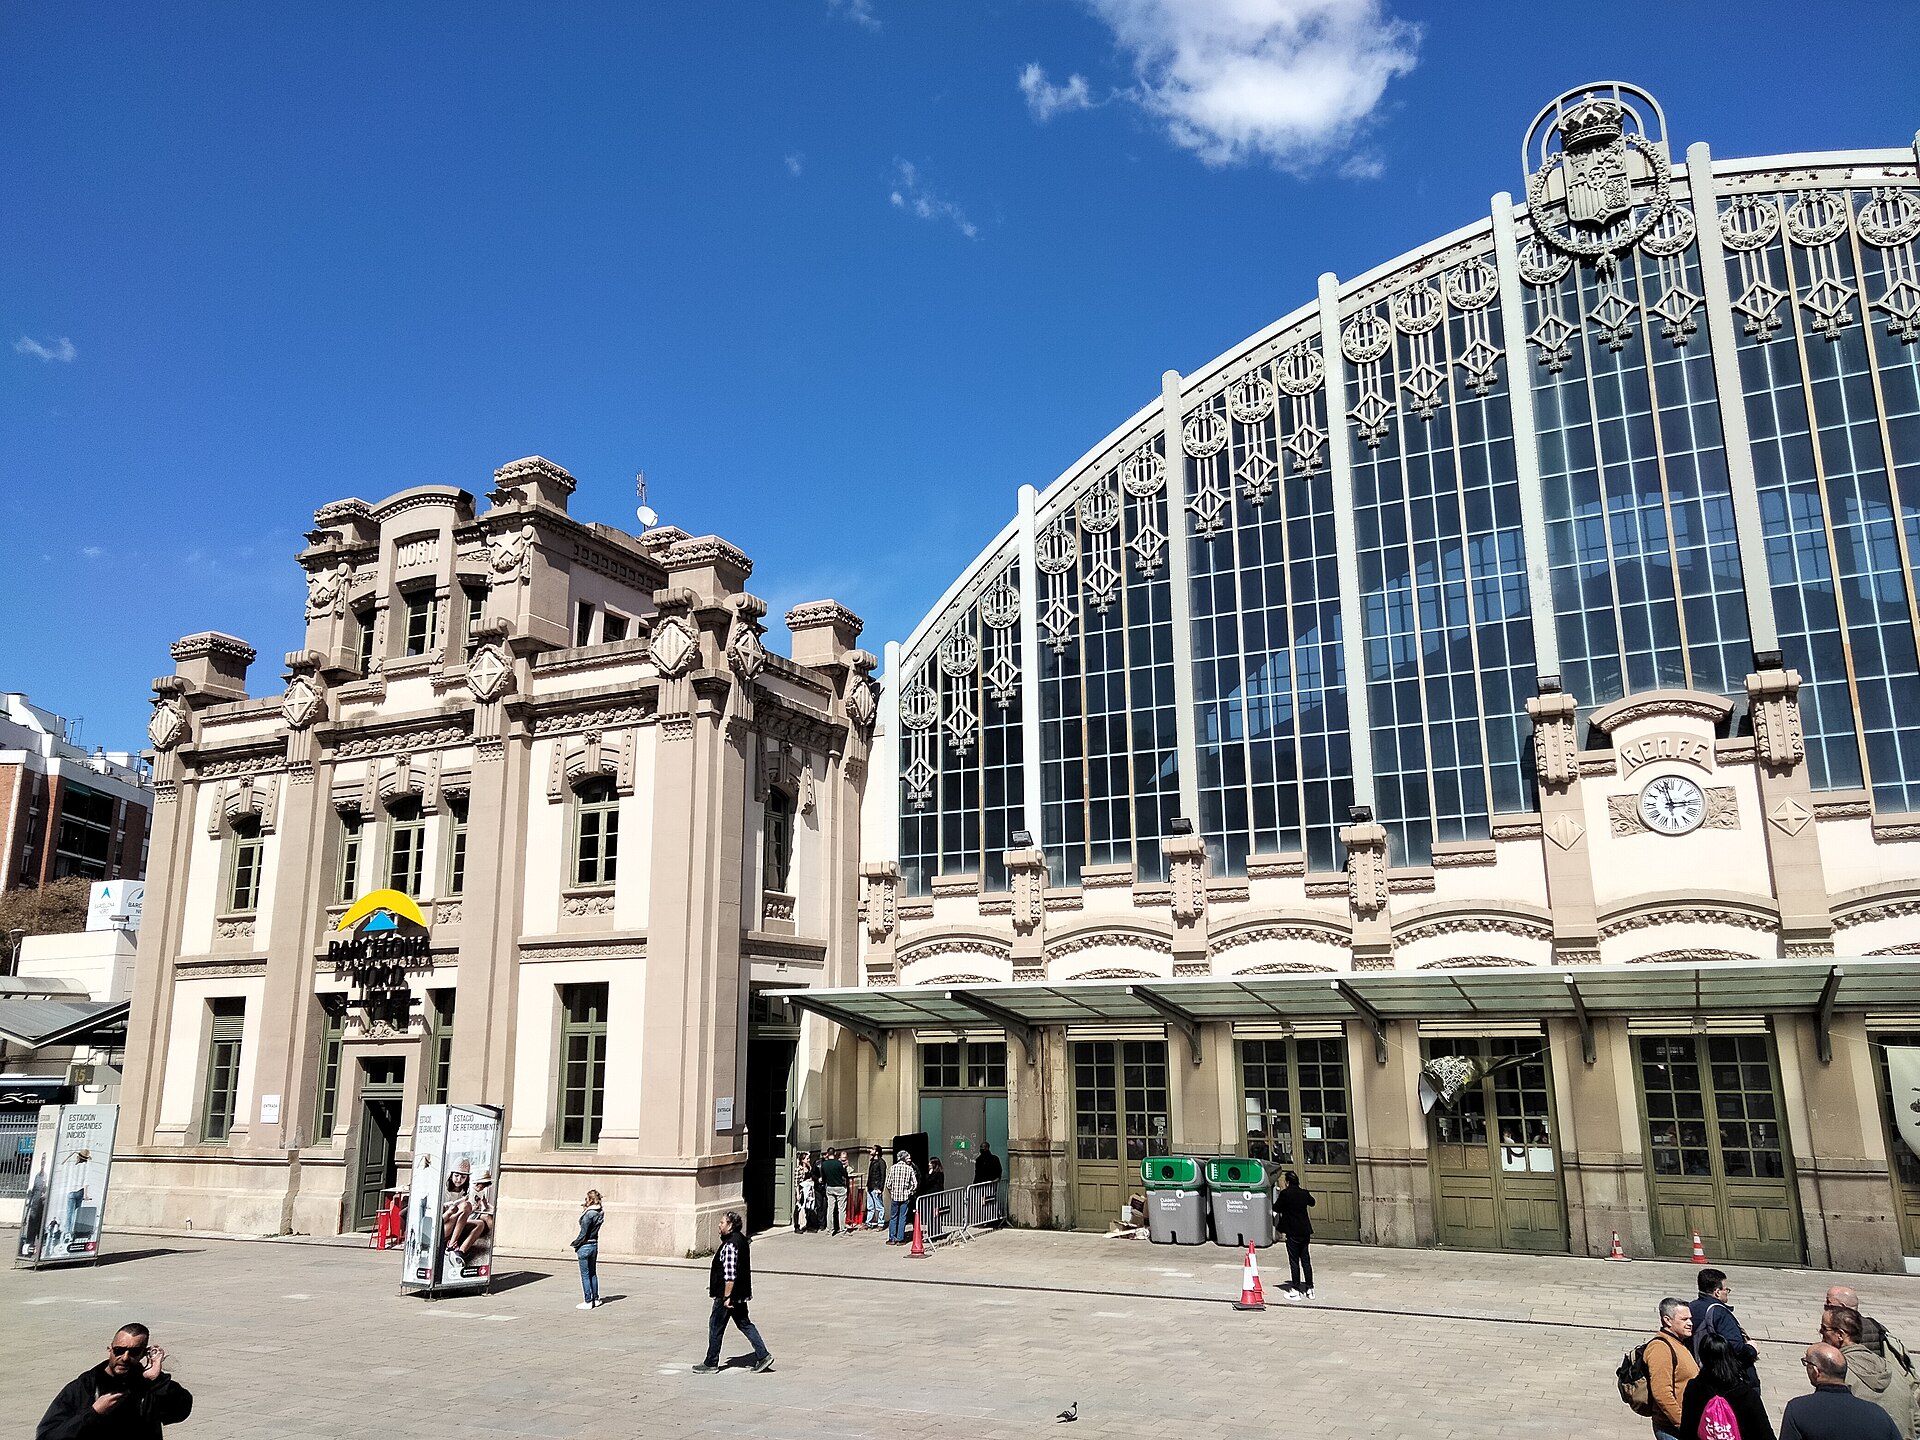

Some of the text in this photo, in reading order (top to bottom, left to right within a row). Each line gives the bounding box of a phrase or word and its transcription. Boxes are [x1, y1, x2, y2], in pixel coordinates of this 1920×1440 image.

[328, 937, 431, 961] BARCELONA
[68, 1114, 96, 1122] ESTACIÓN
[454, 1114, 474, 1122] ESTACIÓ
[460, 1124, 499, 1132] RETROBAMENTS
[66, 1131, 86, 1139] INICIOS
